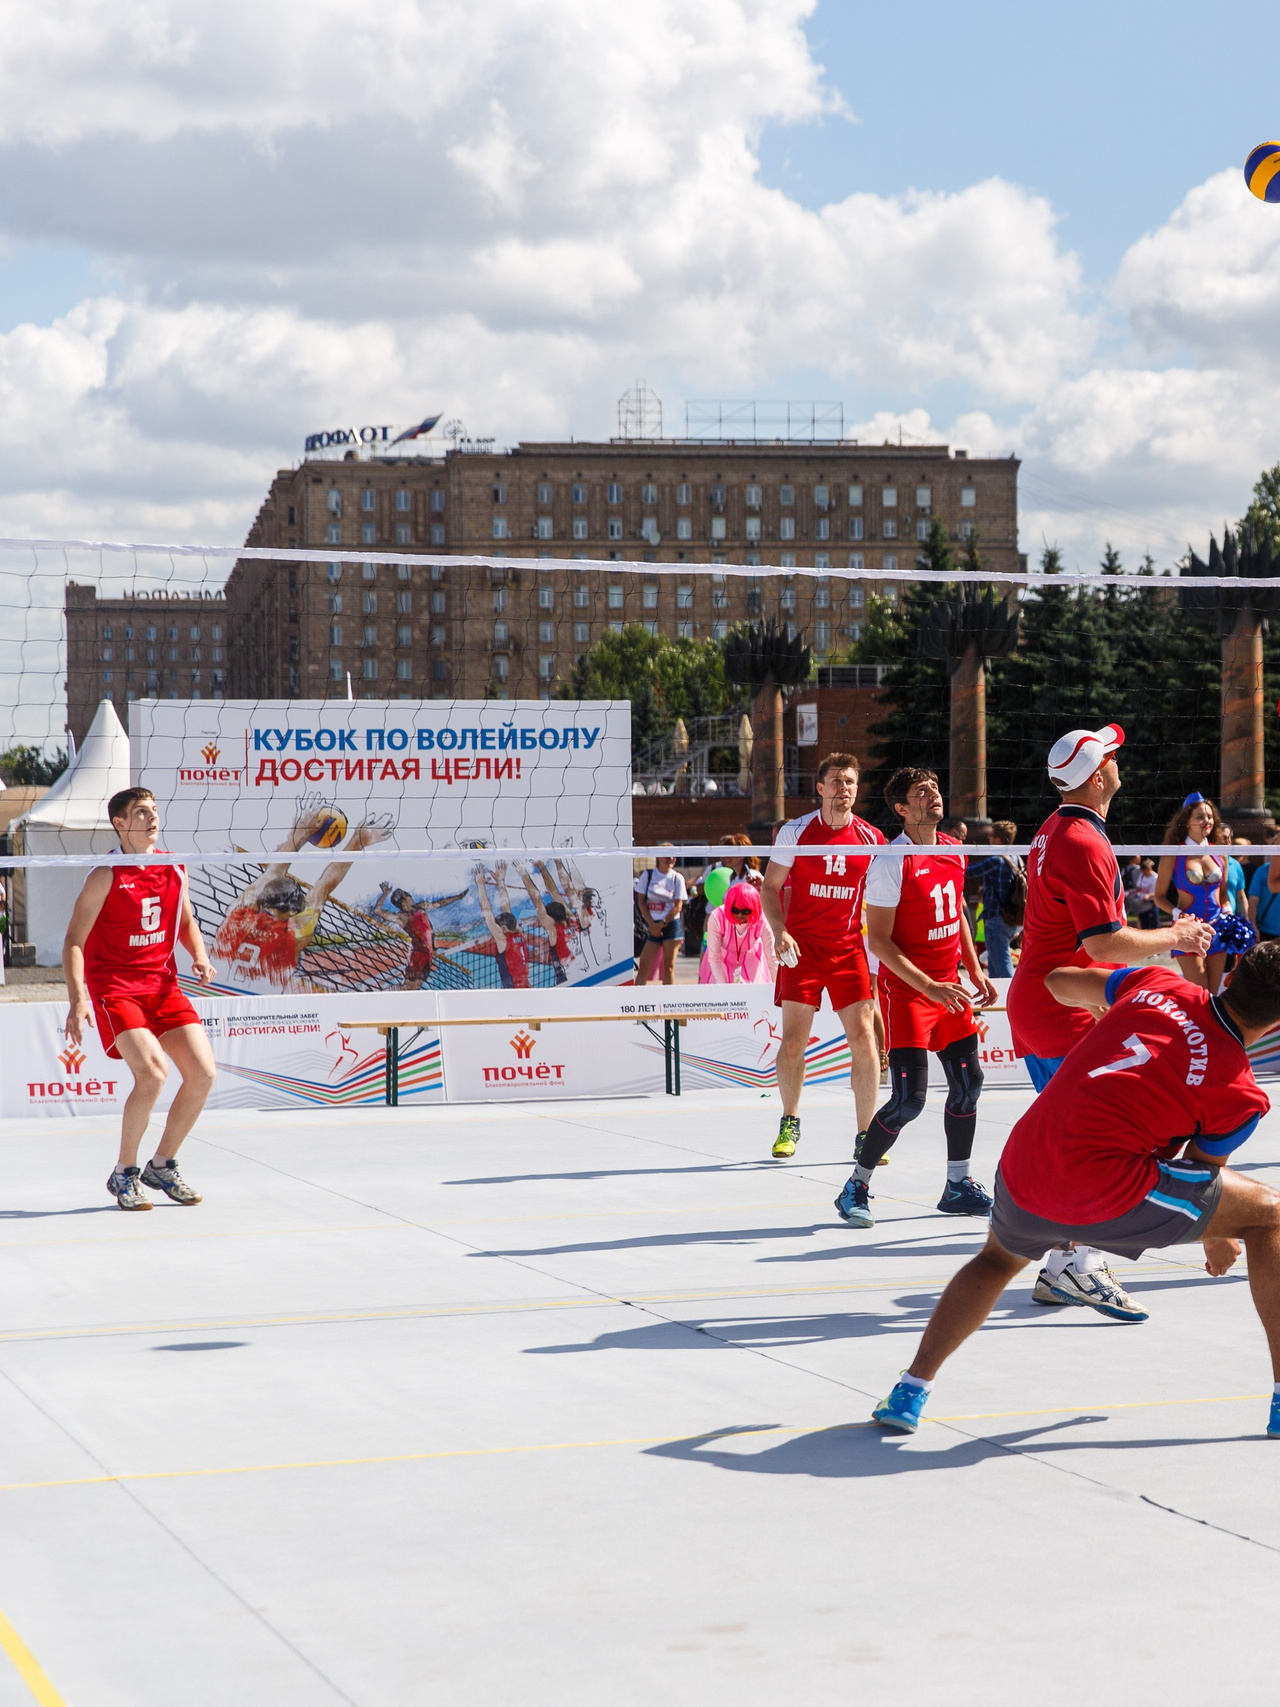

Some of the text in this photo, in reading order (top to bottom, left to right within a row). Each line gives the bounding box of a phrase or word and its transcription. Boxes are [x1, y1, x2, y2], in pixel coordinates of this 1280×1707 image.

[254, 722, 600, 751] КУБОК ПО ВОЛЕЙБОЛУ
[179, 768, 241, 781] почёт
[255, 757, 522, 786] ДОСТИГАЯ ЦЕЛИ!
[823, 855, 847, 877] 14
[809, 883, 855, 900] МАГНИТ
[929, 880, 958, 923] 11
[141, 896, 162, 931] 5
[129, 930, 166, 947] МАГНИТ
[928, 919, 960, 941] МАГНИТ
[227, 1014, 298, 1022] БЛАГОТВОРИТЕЛЬНЫЙ
[620, 1005, 635, 1013] 180
[228, 1024, 320, 1037] ДОСТИГАЯ ЦЕЛИ!
[1131, 989, 1208, 1086] ЛОКОМОТИВ
[978, 1046, 1015, 1063] чёт
[1087, 1032, 1153, 1078] 7
[482, 1062, 565, 1081] почёт
[27, 1078, 118, 1097] почёт
